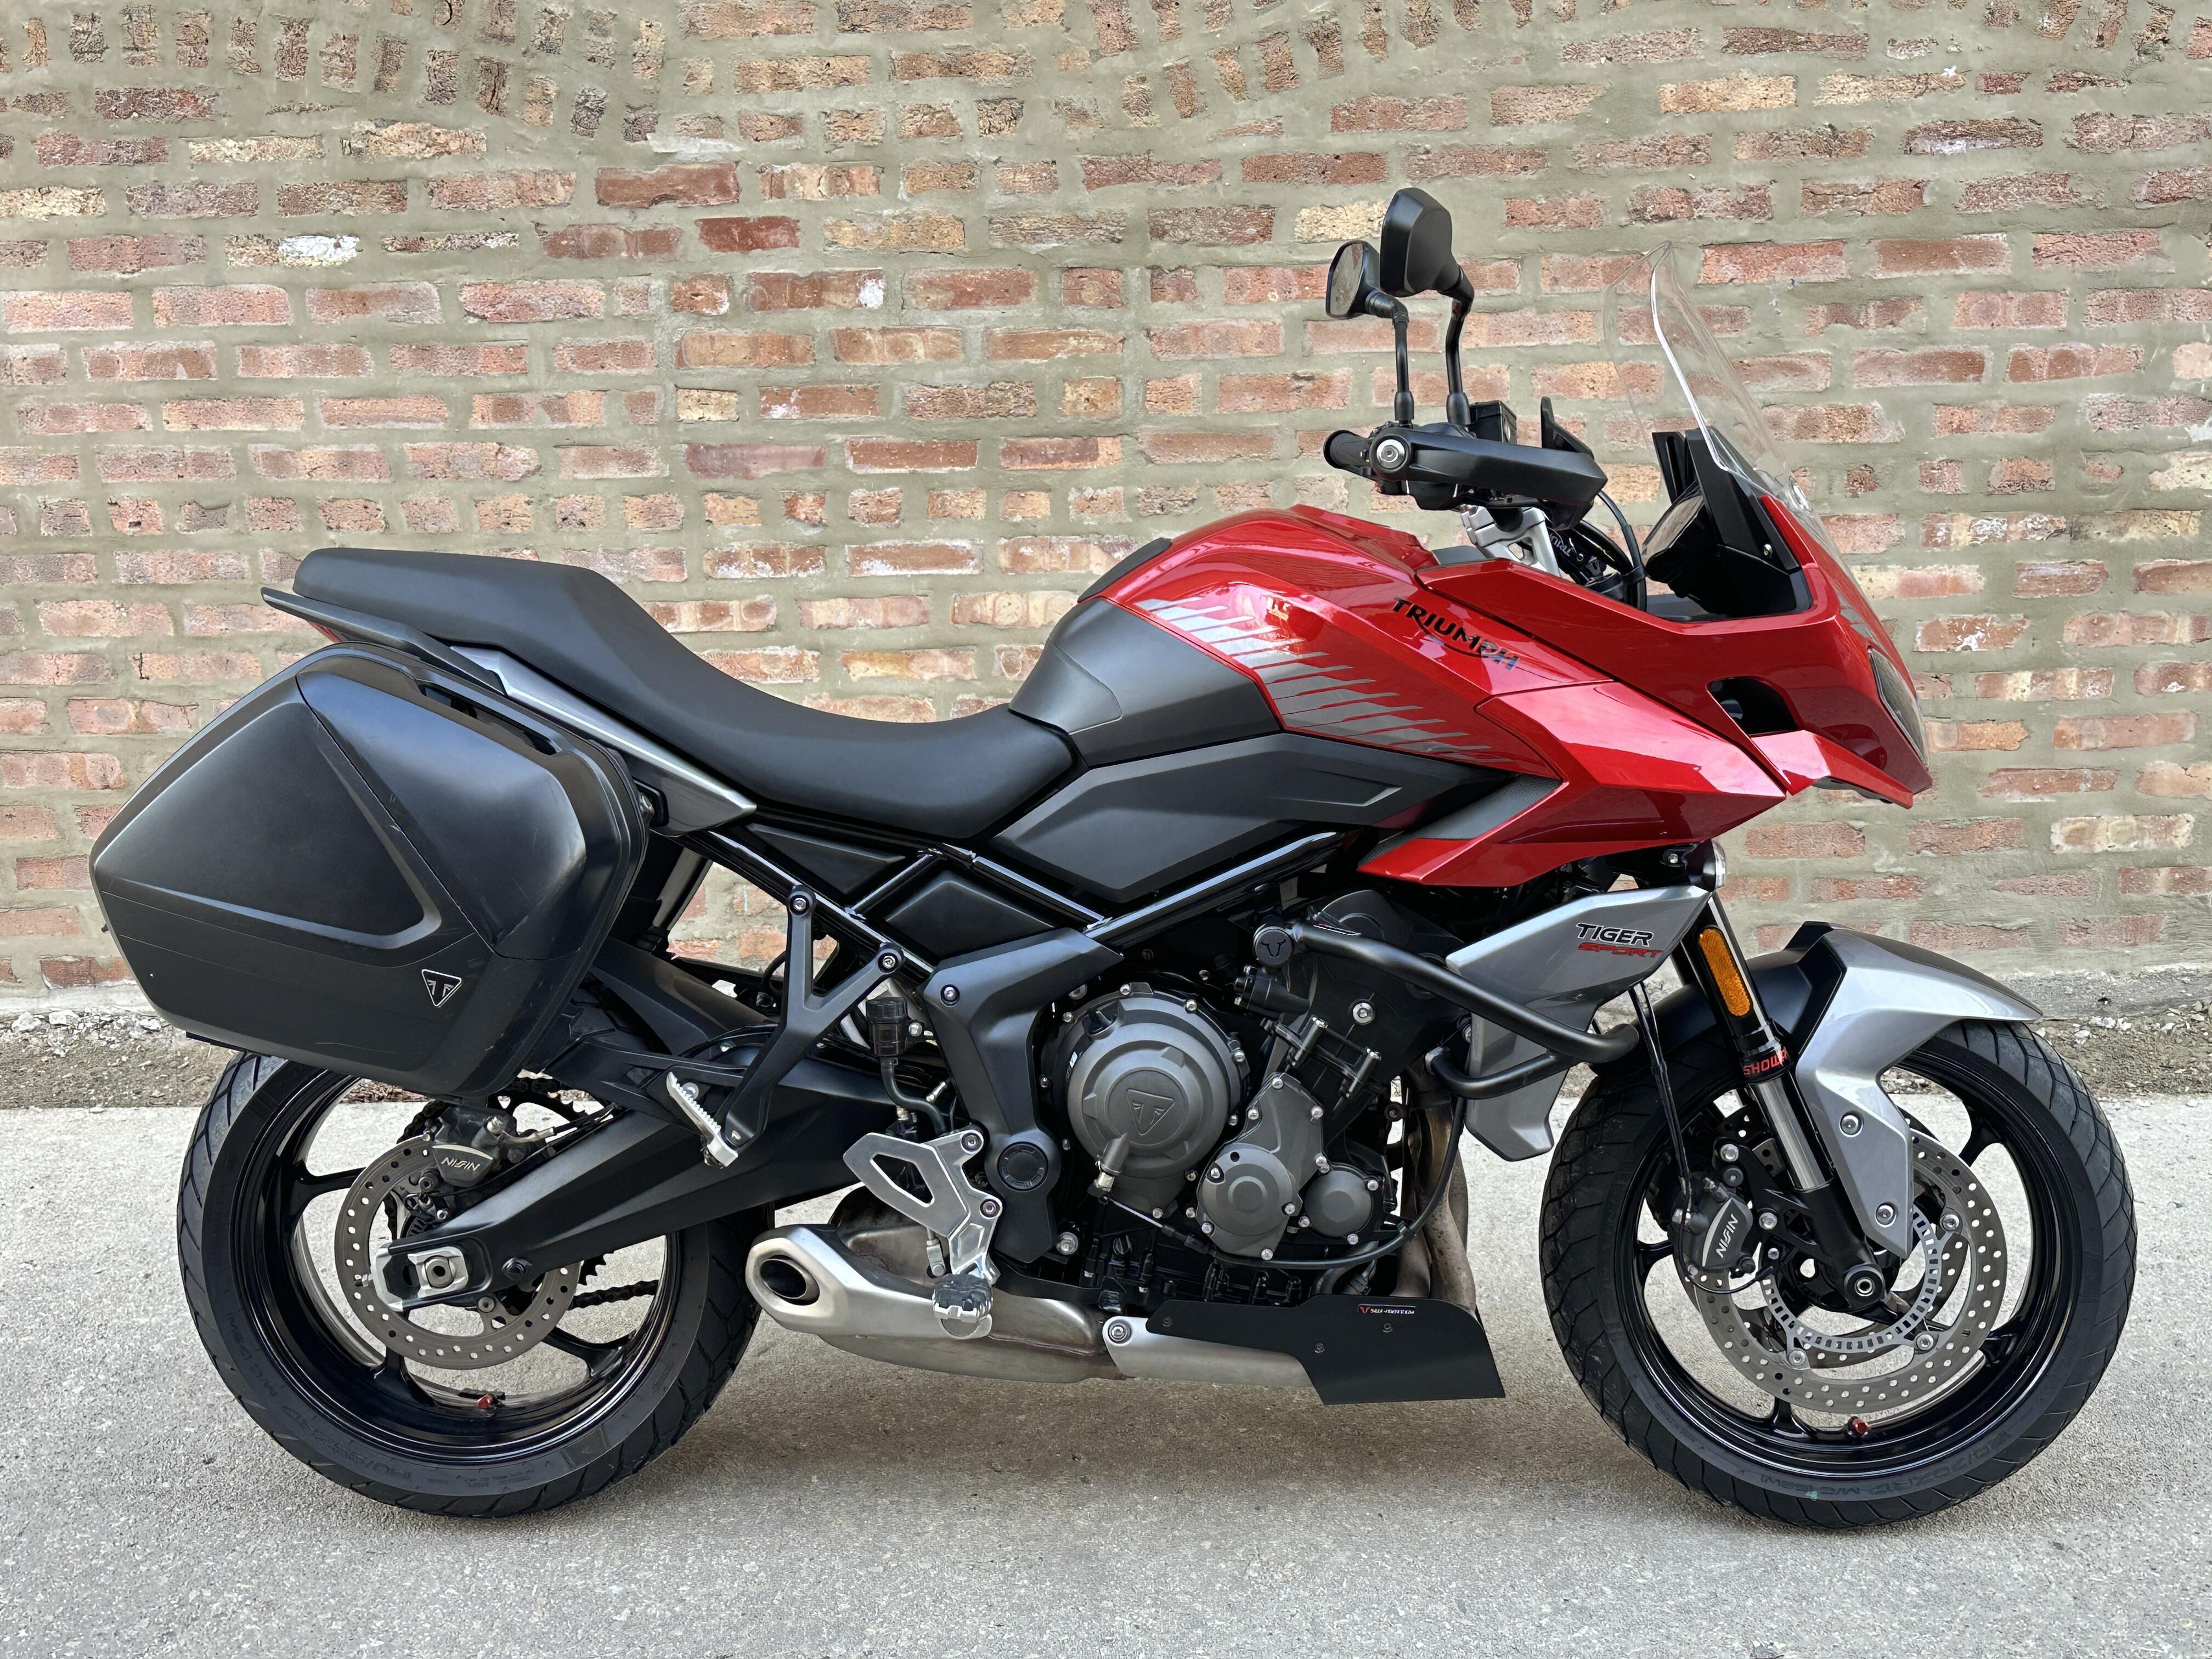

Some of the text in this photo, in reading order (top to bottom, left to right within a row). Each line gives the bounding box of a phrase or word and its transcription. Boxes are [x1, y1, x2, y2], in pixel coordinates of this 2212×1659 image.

[1392, 596, 1520, 670] TRIUMPH
[1576, 923, 1654, 947] TIGER
[1578, 942, 1663, 958] SPORT
[441, 1157, 481, 1171] NISSIN
[1716, 1214, 1739, 1258] NISSIN
